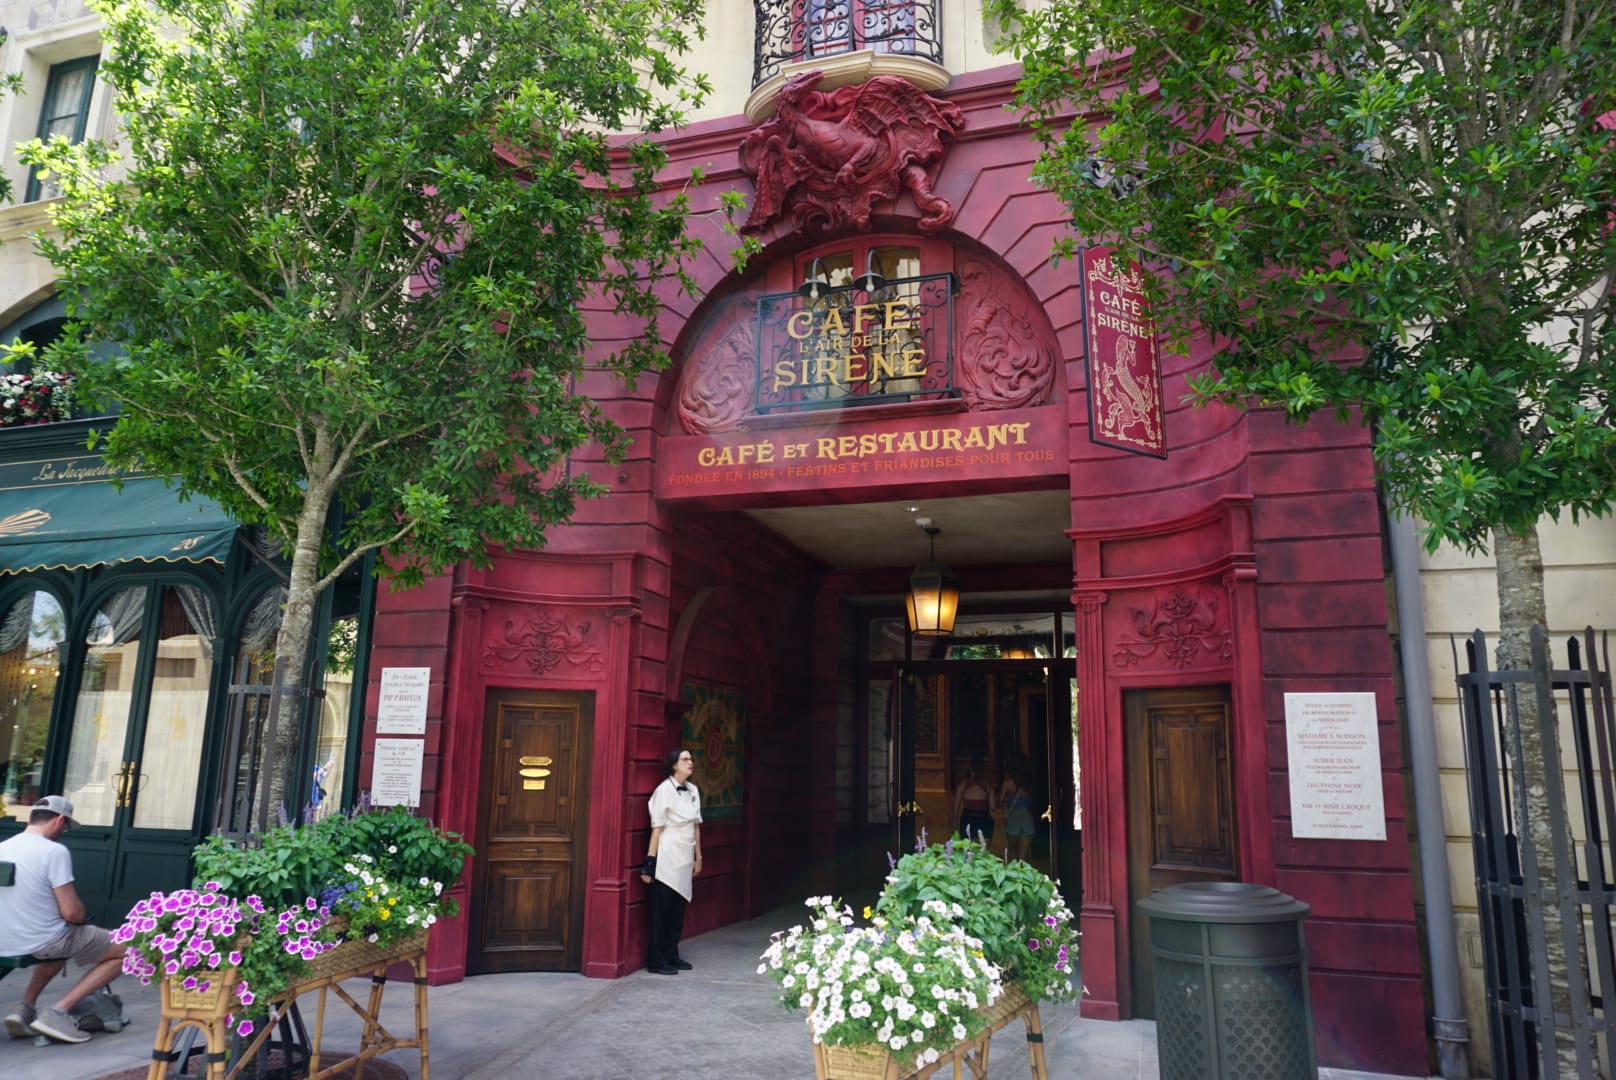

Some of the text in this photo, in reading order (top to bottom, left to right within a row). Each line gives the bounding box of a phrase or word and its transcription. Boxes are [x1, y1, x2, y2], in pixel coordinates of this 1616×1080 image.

[787, 295, 912, 339] CAFÉ
[1100, 291, 1141, 316] CAFÉ
[1097, 312, 1148, 339] SIRÈNE
[800, 332, 901, 353] L'AIR DE LA
[773, 348, 928, 393] SIRÈNE
[698, 422, 1030, 467] CAFÉ ET RESTAURANT
[33, 463, 56, 480] La
[725, 471, 743, 483] EN
[748, 468, 776, 480] 1894
[787, 464, 846, 478] FESTINS
[851, 461, 868, 473] ET
[874, 455, 965, 472] FRIANDISES
[970, 452, 1011, 465] POUR
[1015, 450, 1055, 463] TOUS
